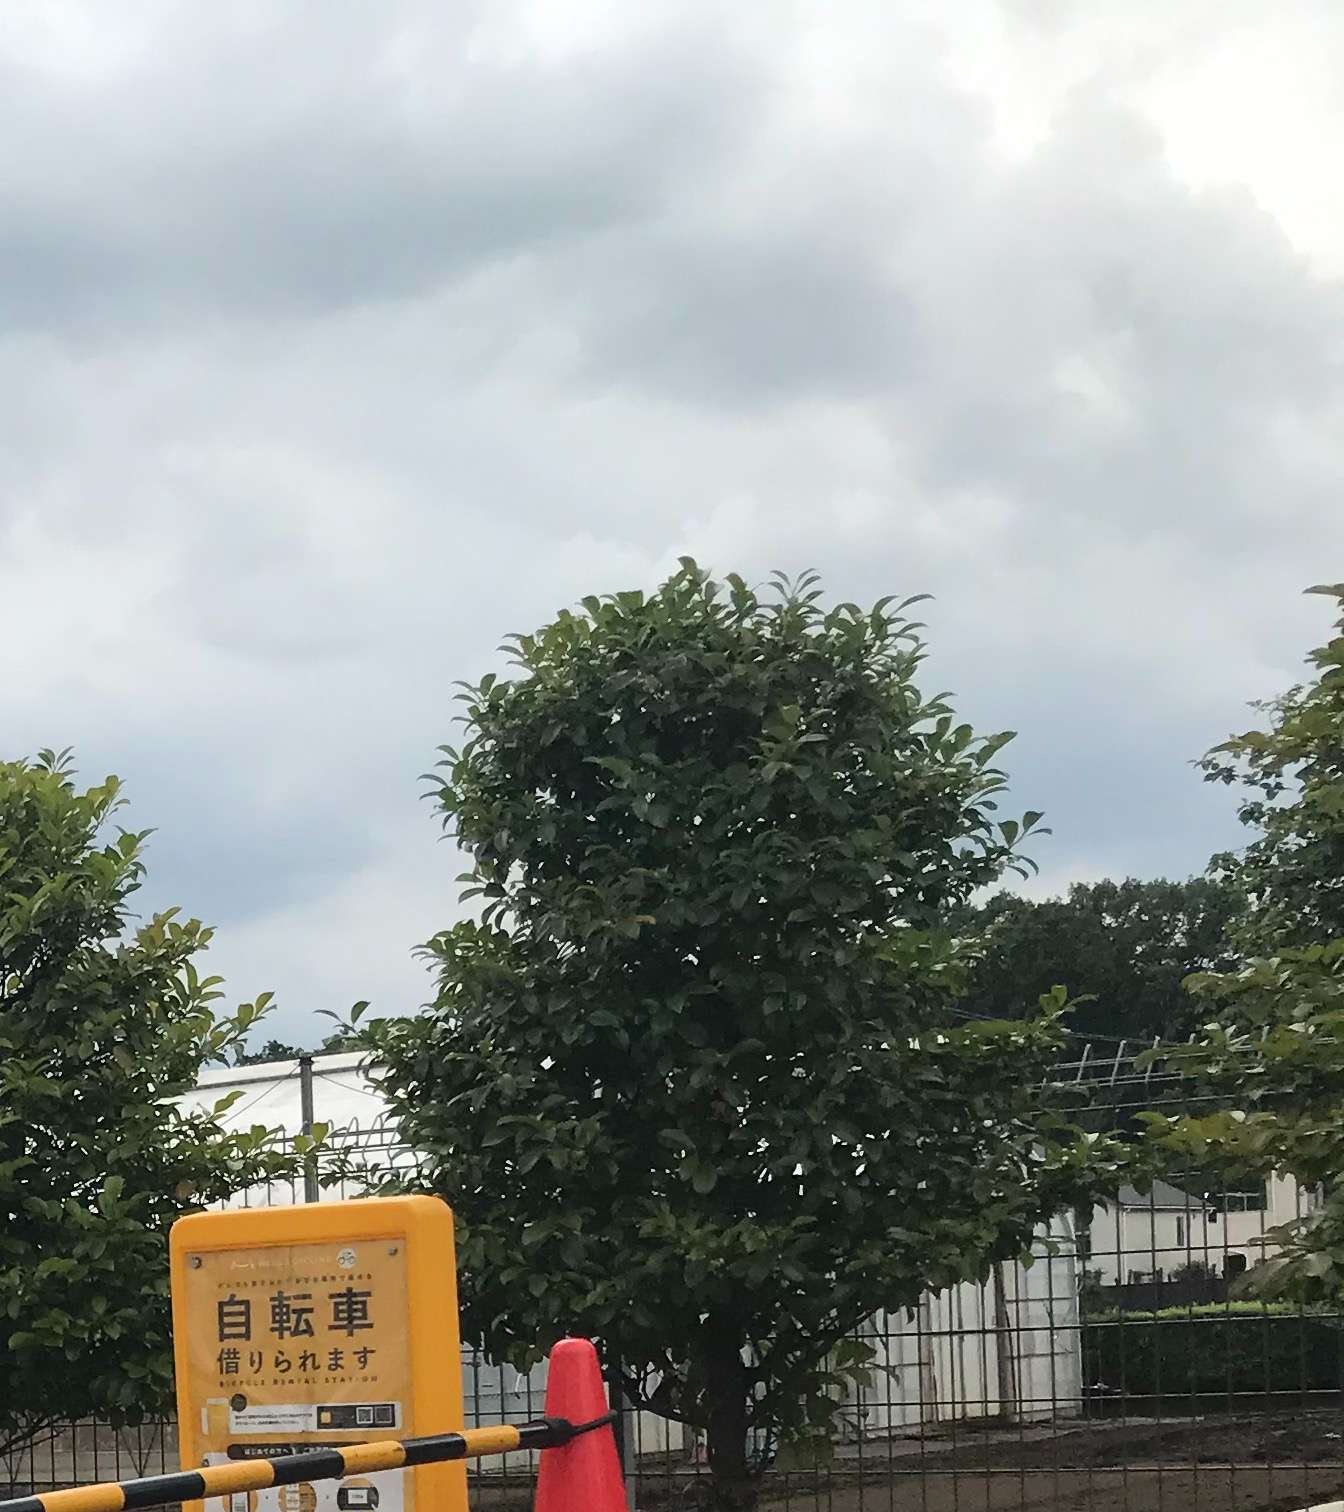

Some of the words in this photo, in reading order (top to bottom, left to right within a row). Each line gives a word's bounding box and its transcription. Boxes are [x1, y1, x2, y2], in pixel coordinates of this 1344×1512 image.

[216, 1287, 374, 1342] 自転車
[216, 1346, 377, 1376] 借りられます
